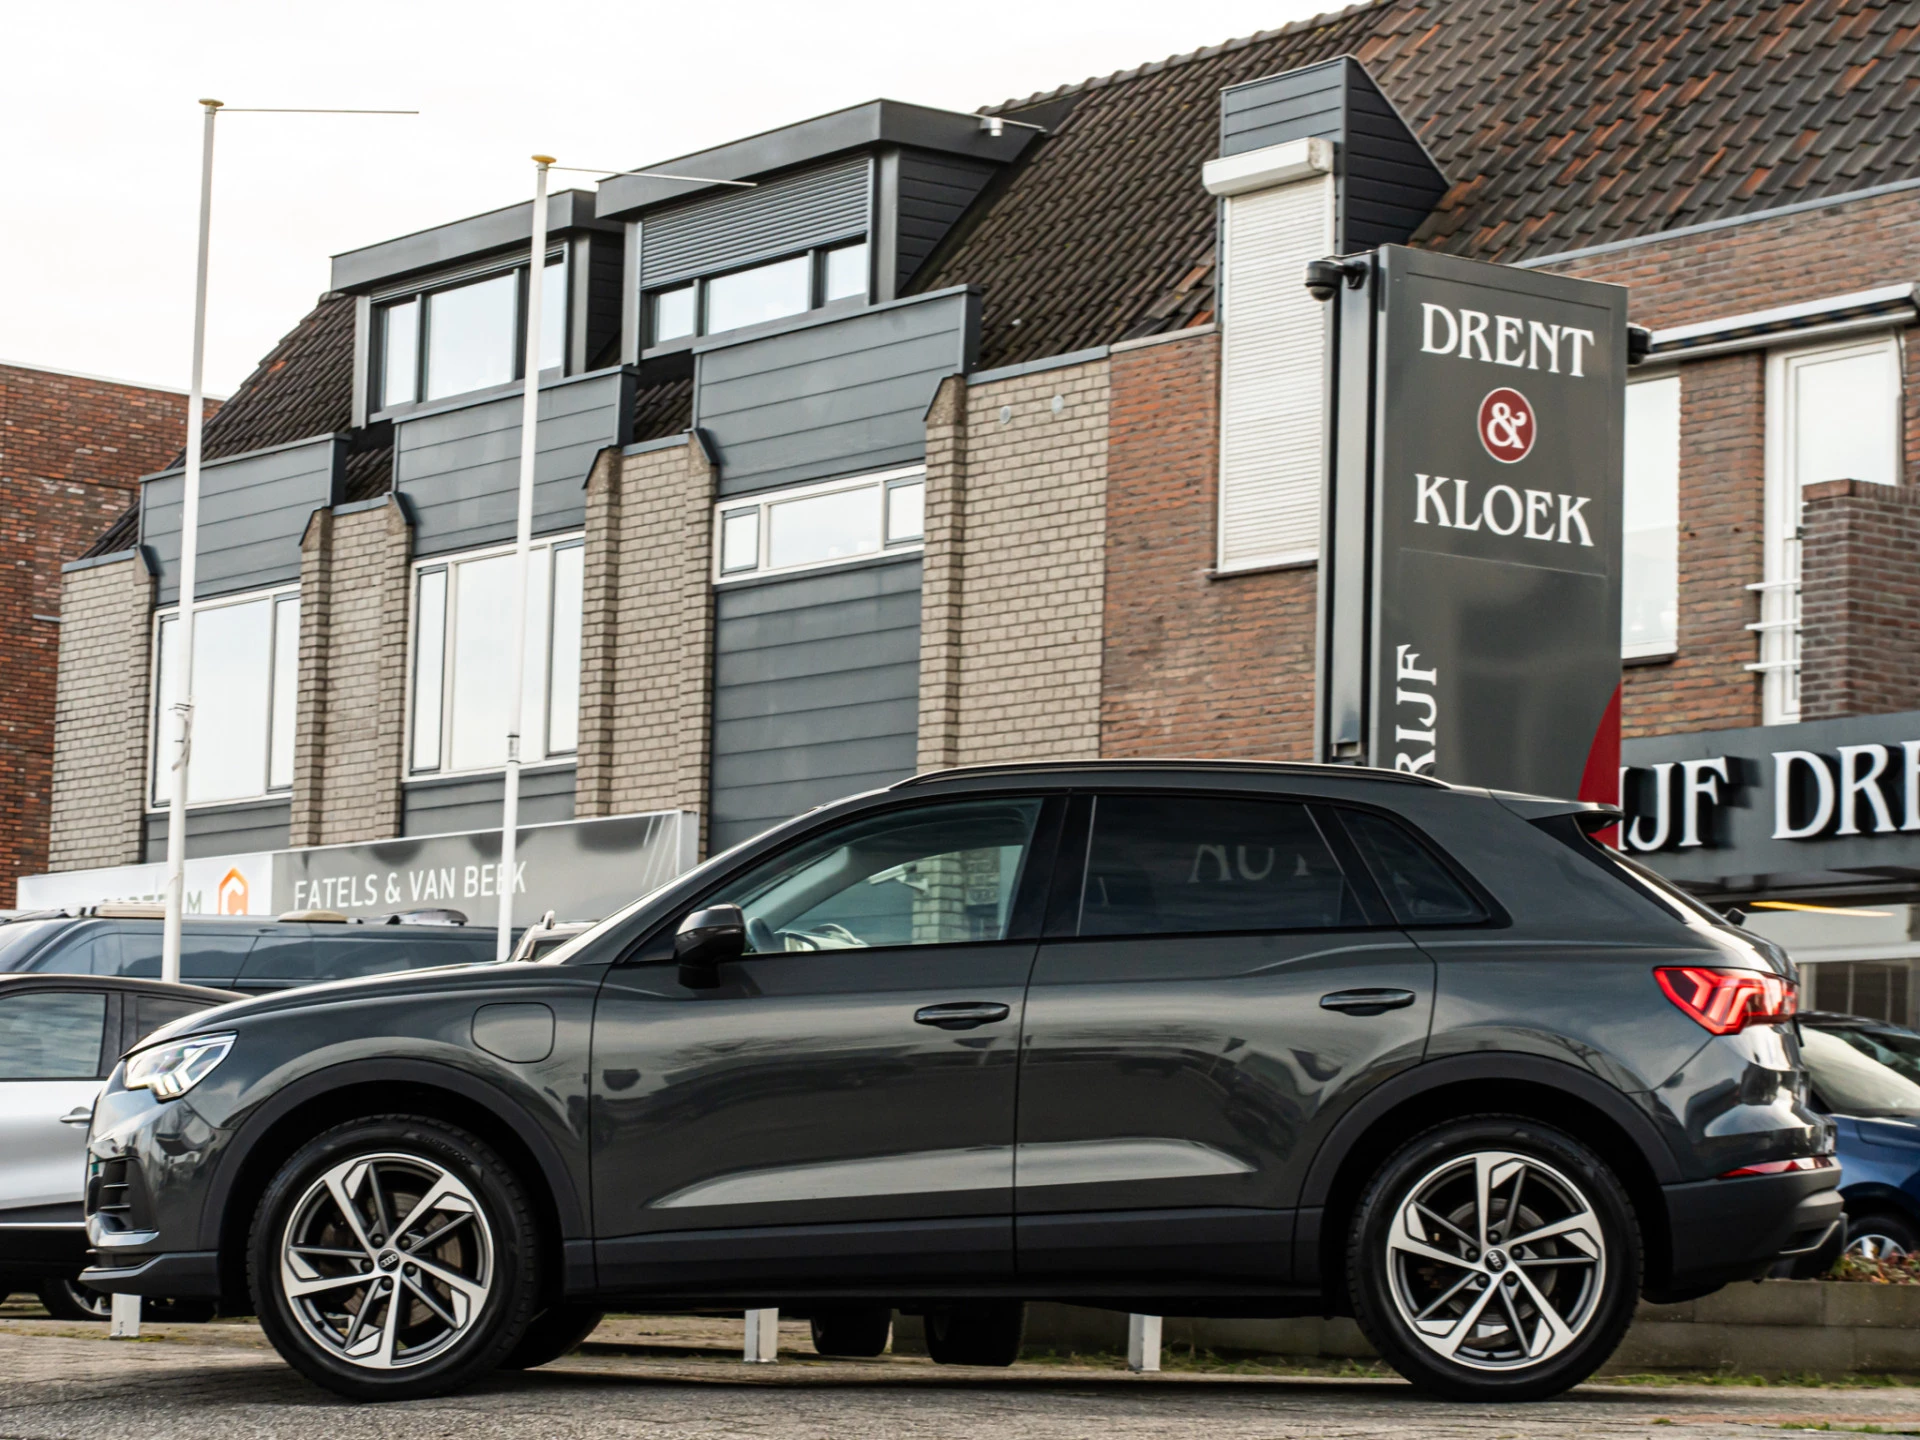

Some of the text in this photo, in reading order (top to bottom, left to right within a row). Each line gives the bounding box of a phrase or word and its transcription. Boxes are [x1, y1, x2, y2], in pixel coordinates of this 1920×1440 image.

[1420, 302, 1595, 378] DRENT
[1486, 401, 1527, 450] &
[1413, 473, 1595, 547] KLOEK
[294, 873, 378, 911] FATELS
[385, 871, 401, 905] &
[409, 866, 456, 903] VAN
